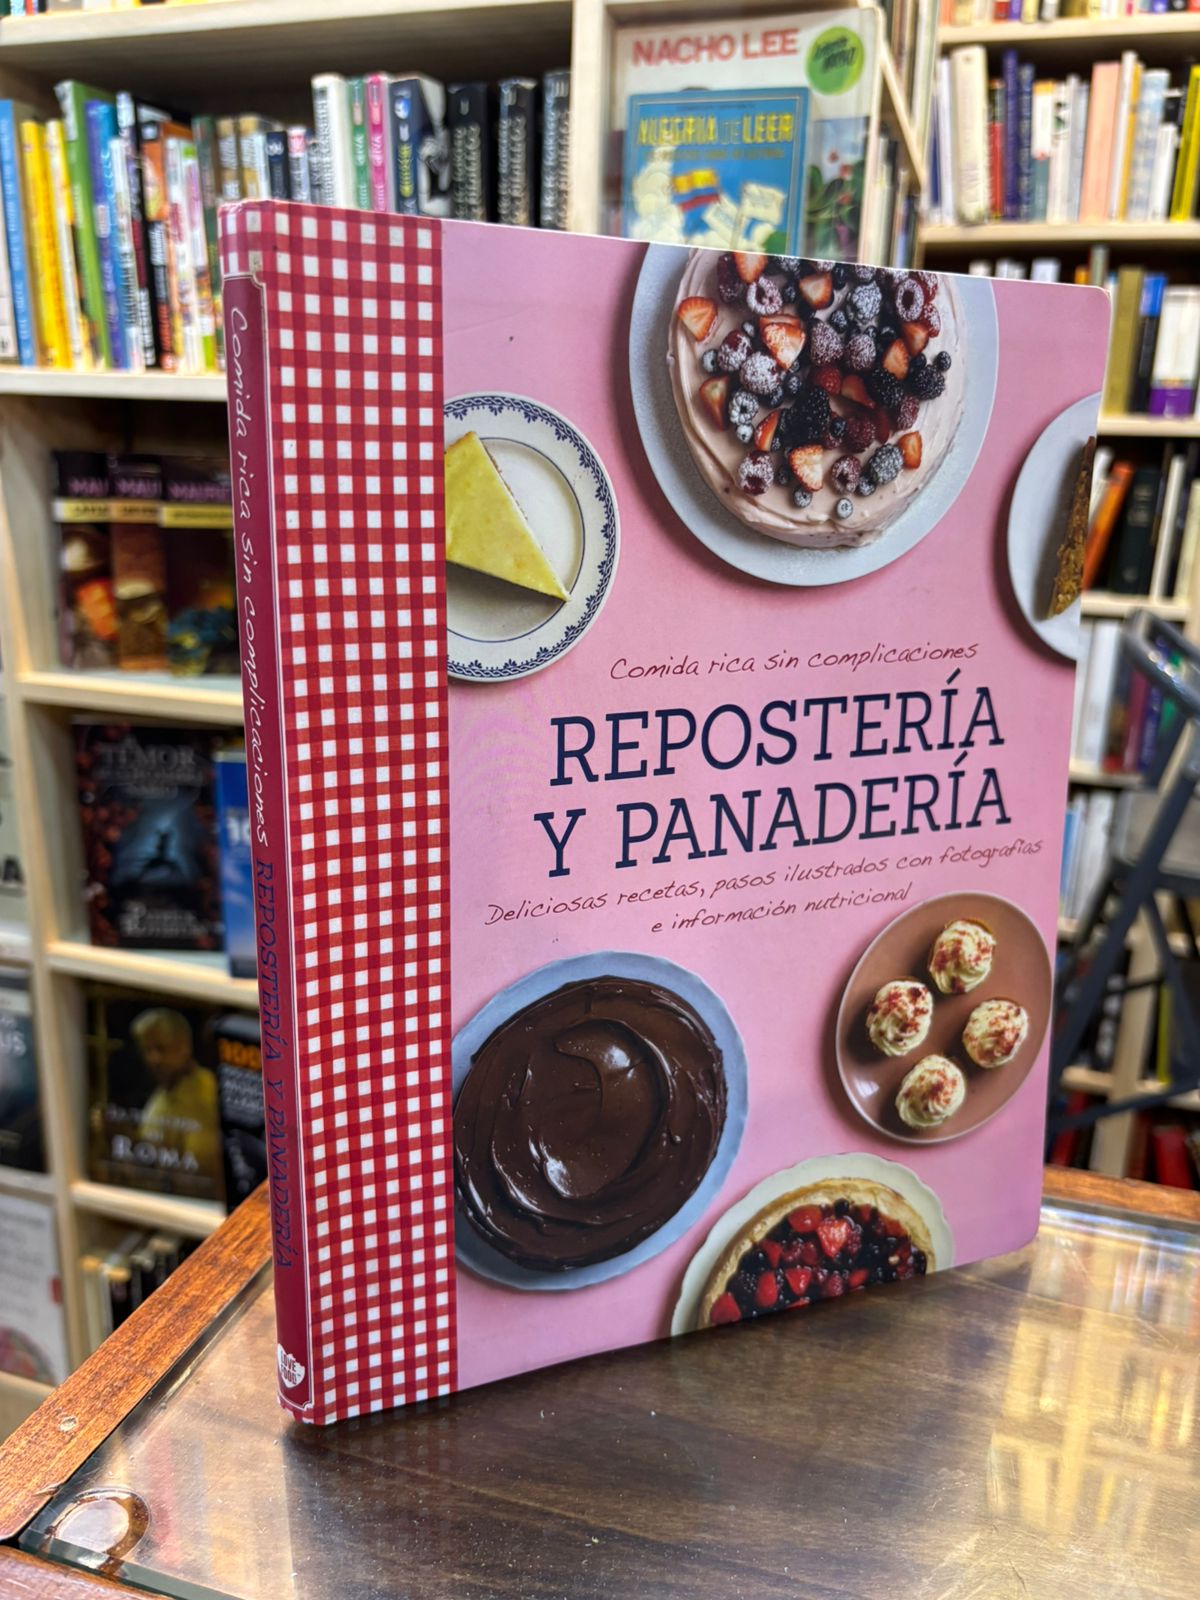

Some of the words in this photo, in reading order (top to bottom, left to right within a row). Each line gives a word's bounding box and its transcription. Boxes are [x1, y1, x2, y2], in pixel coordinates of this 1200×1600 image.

[631, 33, 737, 67] NACHO
[742, 28, 800, 59] LEE
[743, 112, 794, 143] LEER
[230, 307, 252, 437] Comida
[237, 450, 255, 519] rica
[241, 532, 259, 584] sin
[609, 655, 699, 680] Comida
[707, 652, 756, 673] rica
[763, 649, 799, 671] sin
[807, 642, 979, 672] complicaciones
[243, 595, 267, 847] complicaciones
[549, 667, 1006, 787] REPOSTERÍA
[533, 808, 587, 878] Y
[614, 750, 1012, 869] PANADERÍA
[484, 893, 607, 925] Deliciosas
[616, 880, 705, 905] recetas,
[710, 871, 777, 899] pasos
[783, 857, 889, 883] ilustrados
[895, 852, 932, 870] con
[938, 837, 1043, 869] fotografías
[650, 921, 664, 933] e
[671, 899, 797, 931] información
[803, 881, 913, 913] nutricional
[255, 859, 284, 1060] REPOSTERÍA
[266, 1079, 284, 1096] Y
[111, 1135, 199, 1170] ROMA
[266, 1105, 293, 1270] PANADERÍA
